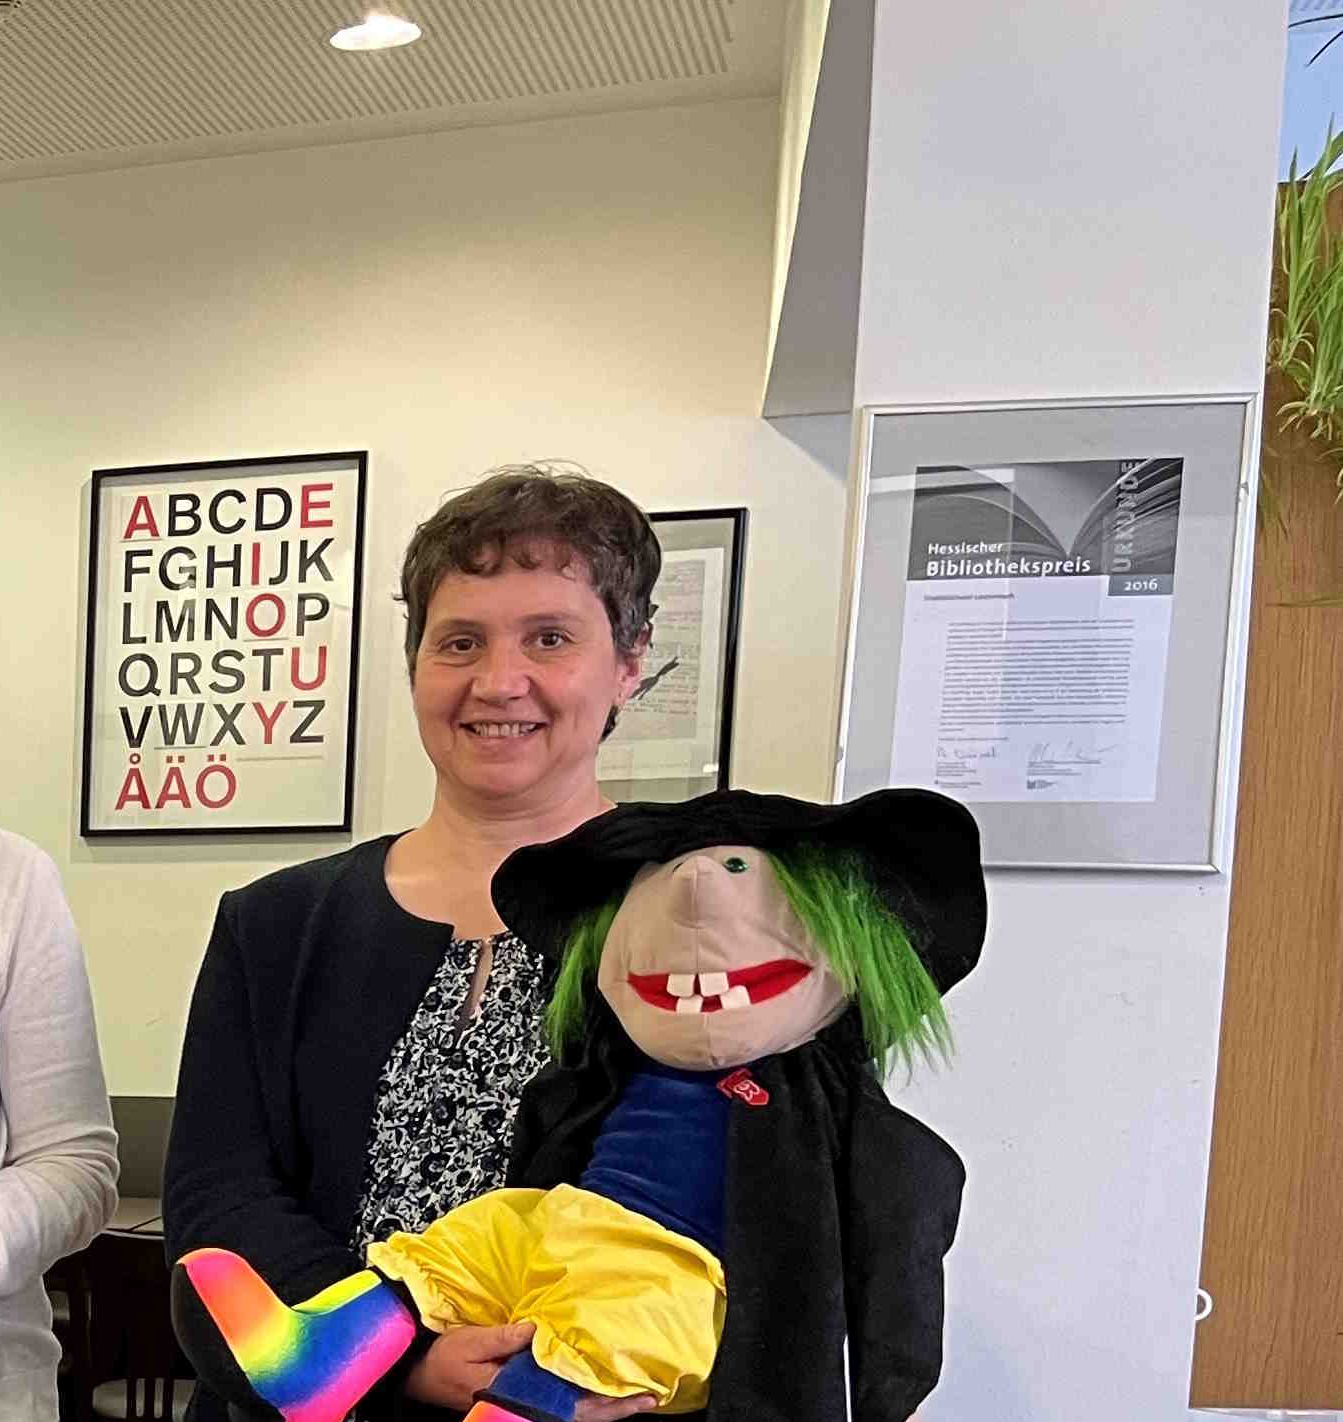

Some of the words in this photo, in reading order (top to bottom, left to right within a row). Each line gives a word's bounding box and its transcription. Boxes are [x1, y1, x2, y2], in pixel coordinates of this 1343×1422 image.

[927, 541, 1003, 555] Hessischer
[926, 556, 1092, 577] Bibliothekspreis
[1123, 579, 1159, 591] 2016
